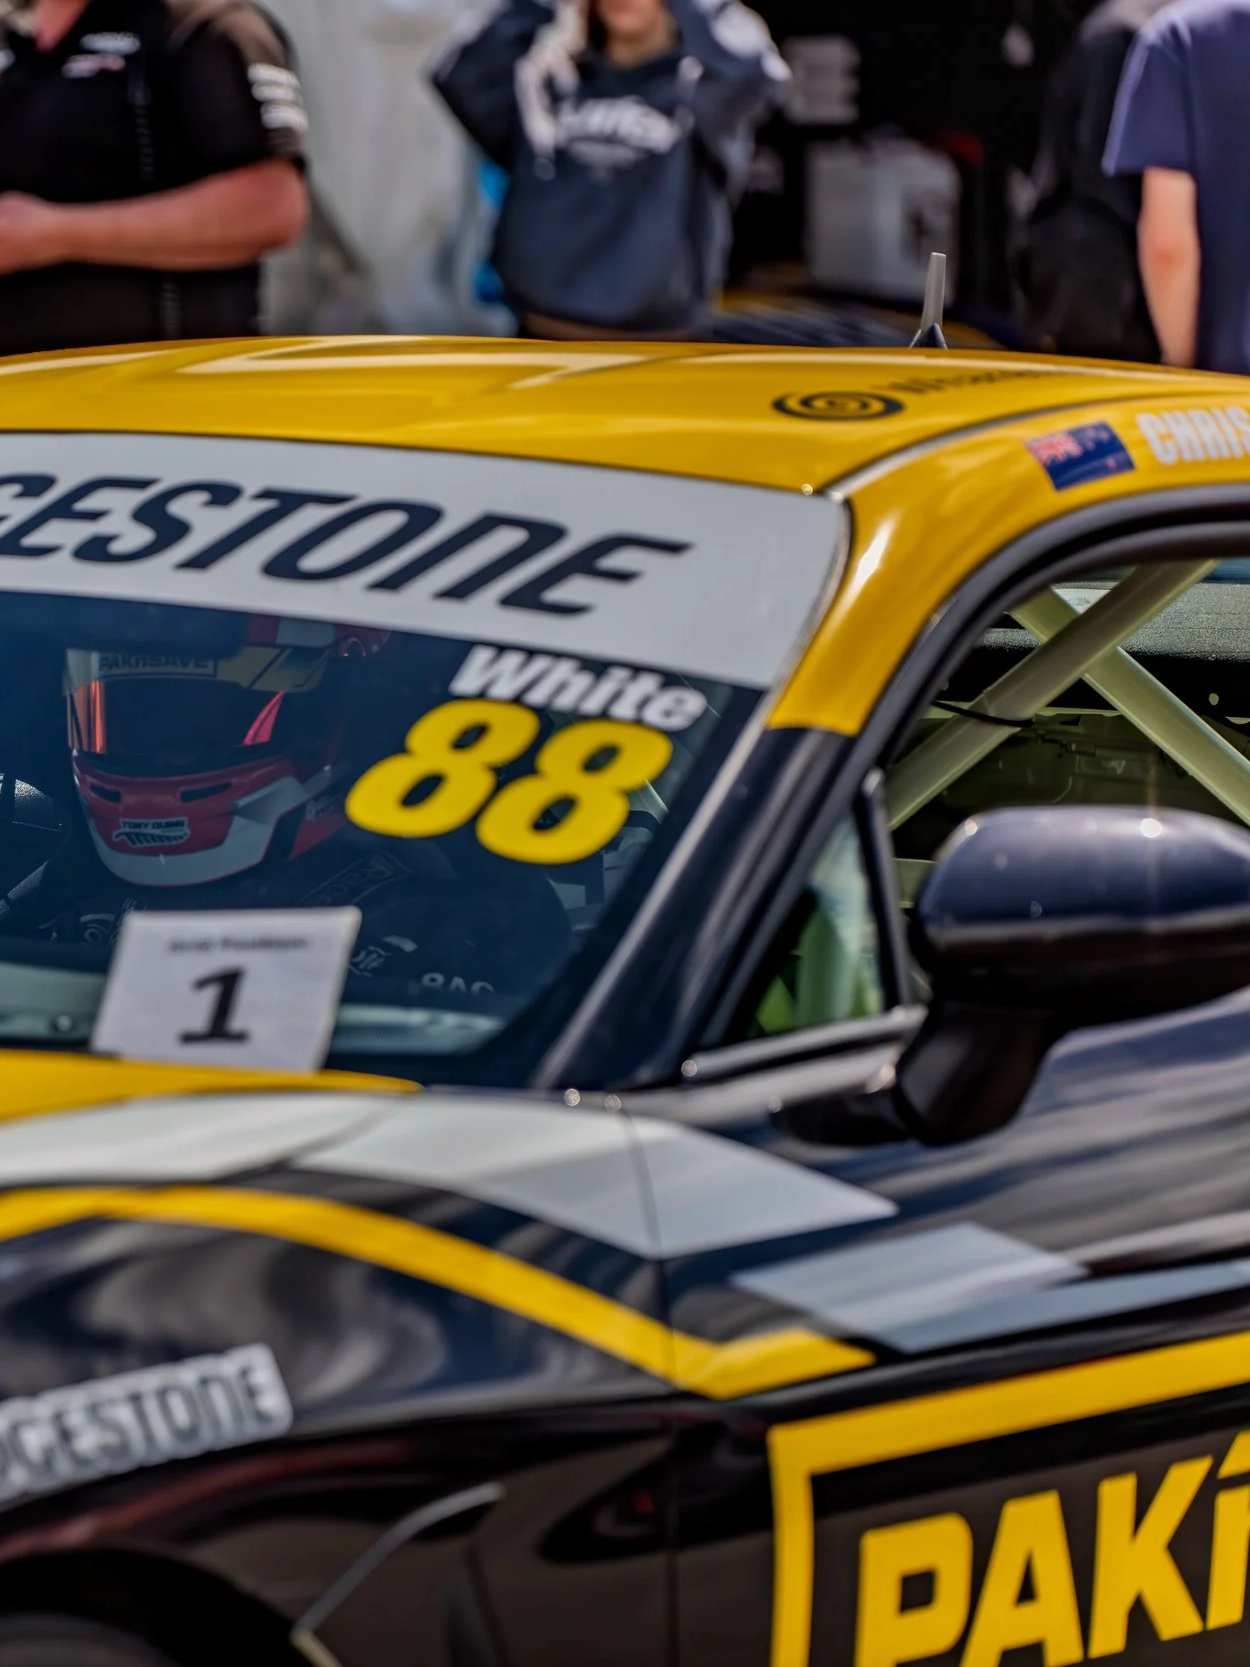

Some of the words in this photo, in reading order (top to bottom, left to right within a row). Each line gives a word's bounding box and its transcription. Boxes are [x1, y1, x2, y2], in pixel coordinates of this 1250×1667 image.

[449, 645, 708, 731] White
[345, 699, 673, 864] 88
[180, 966, 252, 1044] 1
